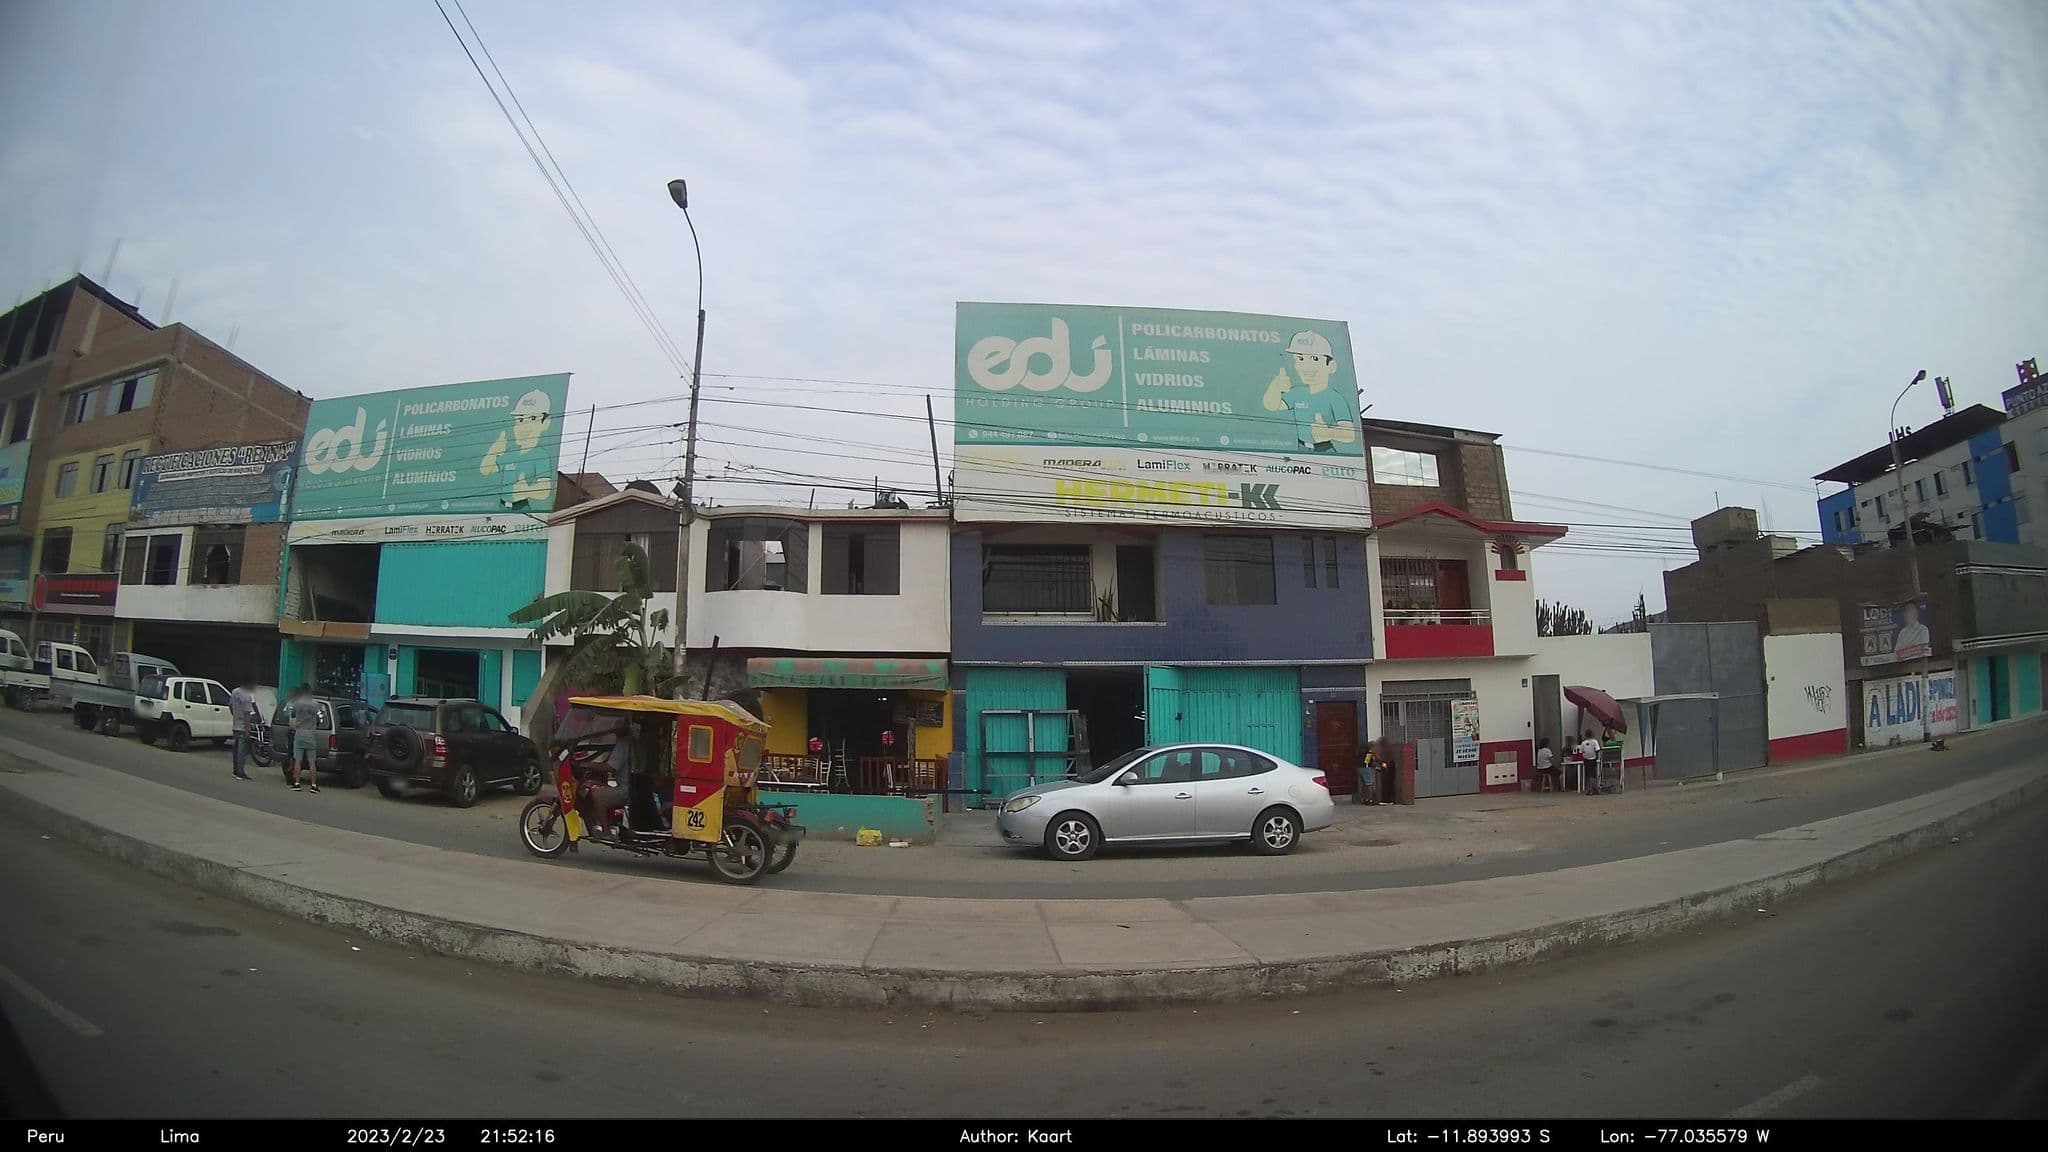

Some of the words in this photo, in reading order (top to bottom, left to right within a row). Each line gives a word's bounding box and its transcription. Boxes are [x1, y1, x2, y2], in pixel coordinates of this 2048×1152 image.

[1132, 323, 1281, 344] POLICARBONATOS
[1133, 345, 1210, 363] LÁMINAS
[1135, 372, 1205, 388] VIDRIOS
[403, 395, 510, 416] POLICARBONATOS
[966, 397, 1045, 408] HOLDING
[1056, 398, 1114, 409] GROUP
[1136, 399, 1233, 415] ALUMINIOS
[400, 423, 452, 438] LÁMINAS
[396, 447, 443, 461] VIDRIOS
[1137, 459, 1191, 470] LamiFlex
[1322, 466, 1355, 477] euro
[392, 470, 457, 485] ALUMINIOS
[384, 525, 418, 535] LamiFlex
[687, 810, 705, 828] 242
